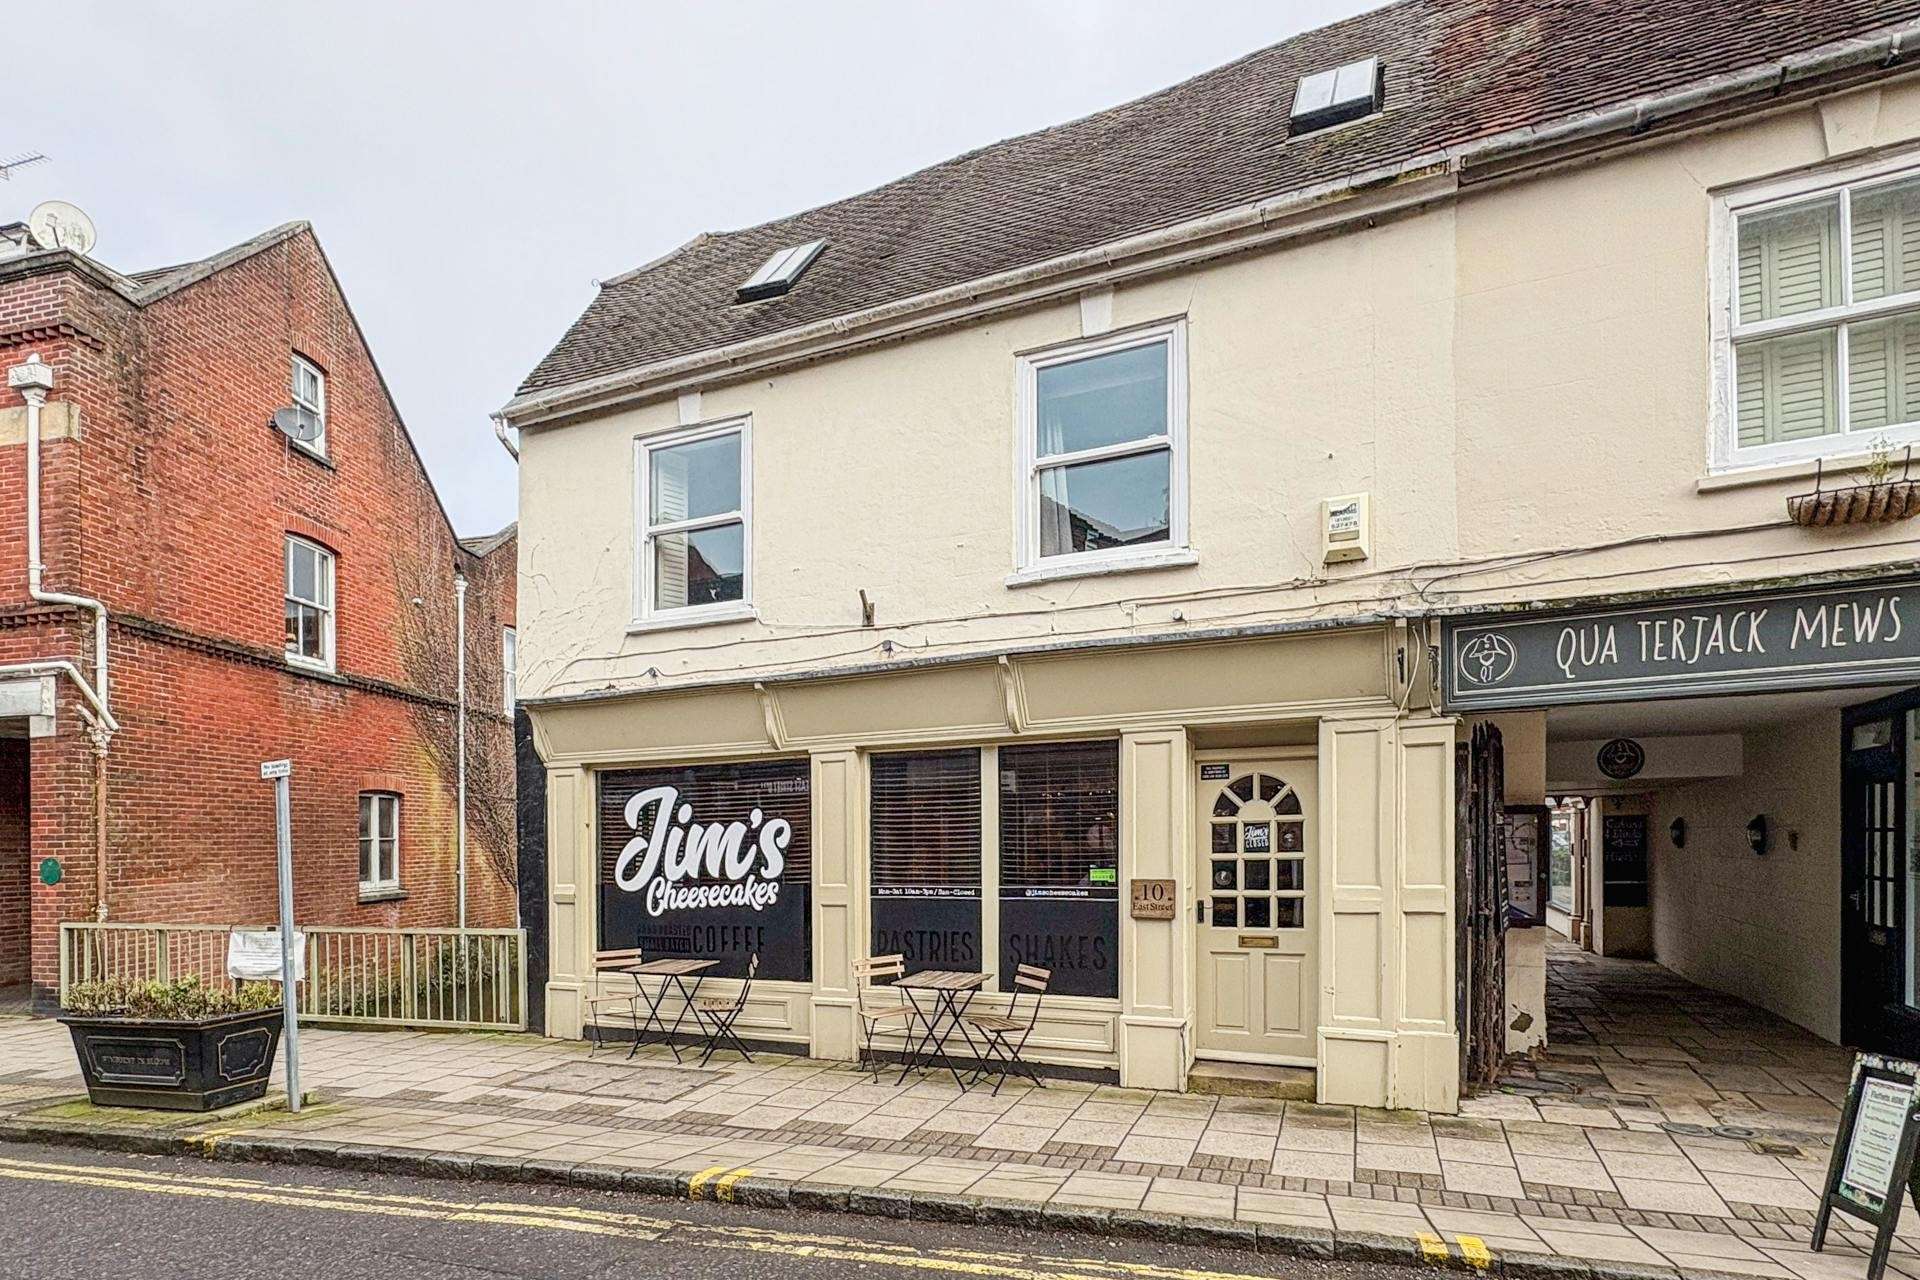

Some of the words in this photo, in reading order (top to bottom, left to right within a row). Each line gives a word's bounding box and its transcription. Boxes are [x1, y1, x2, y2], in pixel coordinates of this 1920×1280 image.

[1790, 596, 1902, 651] MEWS
[614, 785, 792, 892] Jim's
[1245, 838, 1269, 848] CLOSED
[646, 874, 780, 917] Cheesecakes
[1132, 902, 1150, 911] East
[1150, 902, 1174, 911] Street
[1143, 883, 1164, 901] 10
[692, 925, 765, 954] COFFEE
[876, 929, 974, 963] PASTRIES
[1008, 933, 1109, 970] SHAKES
